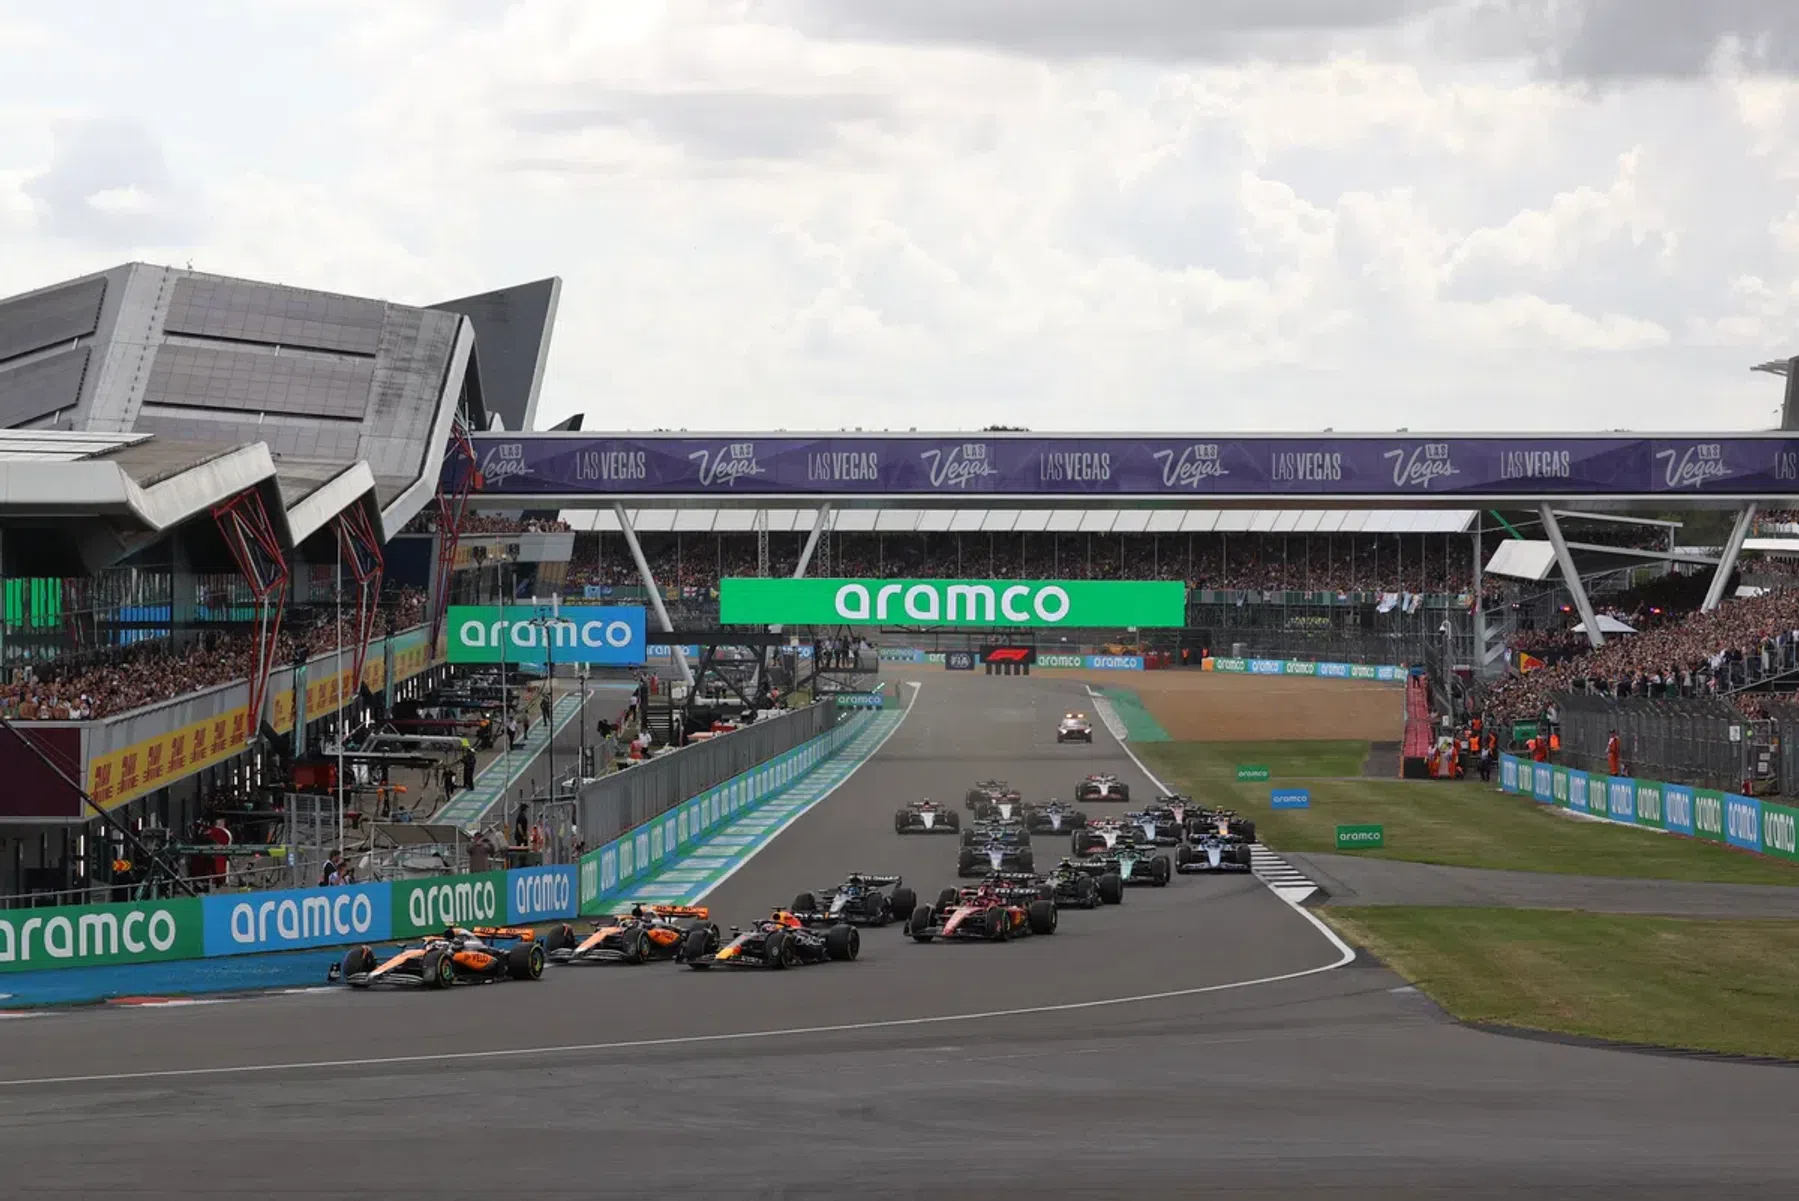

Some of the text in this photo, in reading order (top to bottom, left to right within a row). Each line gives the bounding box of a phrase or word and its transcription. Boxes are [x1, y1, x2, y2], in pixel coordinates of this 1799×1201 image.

[731, 444, 754, 459] LAS
[963, 444, 986, 459] LAS
[1195, 444, 1218, 459] LAS
[1425, 444, 1448, 459] LAS
[1501, 451, 1570, 478] LAS VEGAS
[1698, 444, 1720, 459] LAS
[576, 452, 646, 480] LAS VEGAS
[688, 446, 766, 488] Vegas
[808, 452, 878, 480] LAS VEGAS
[920, 446, 998, 488] Vegas
[1040, 452, 1110, 480] LAS VEGAS
[1153, 446, 1229, 488] Vegas
[1272, 452, 1341, 480] LAS VEGAS
[1384, 446, 1460, 488] Vegas
[1656, 446, 1733, 488] Vegas
[1775, 452, 1797, 480] LAS
[834, 583, 1070, 622] aramco
[460, 620, 632, 648] aramco
[1038, 655, 1081, 667] aramco
[1093, 656, 1137, 668] aramco
[1217, 660, 1245, 671] aramco
[1252, 662, 1278, 673] aramco
[1286, 663, 1314, 674] aramco
[838, 693, 882, 704] aramco
[1238, 769, 1268, 777] aramco
[1272, 794, 1308, 804] aramco
[1339, 831, 1381, 841] aramco
[1728, 802, 1757, 842] aramco
[1764, 811, 1796, 853] aramco
[410, 880, 495, 927] aramco
[515, 874, 569, 912] aramco
[231, 894, 372, 943] aramco
[0, 910, 176, 962] aramco
